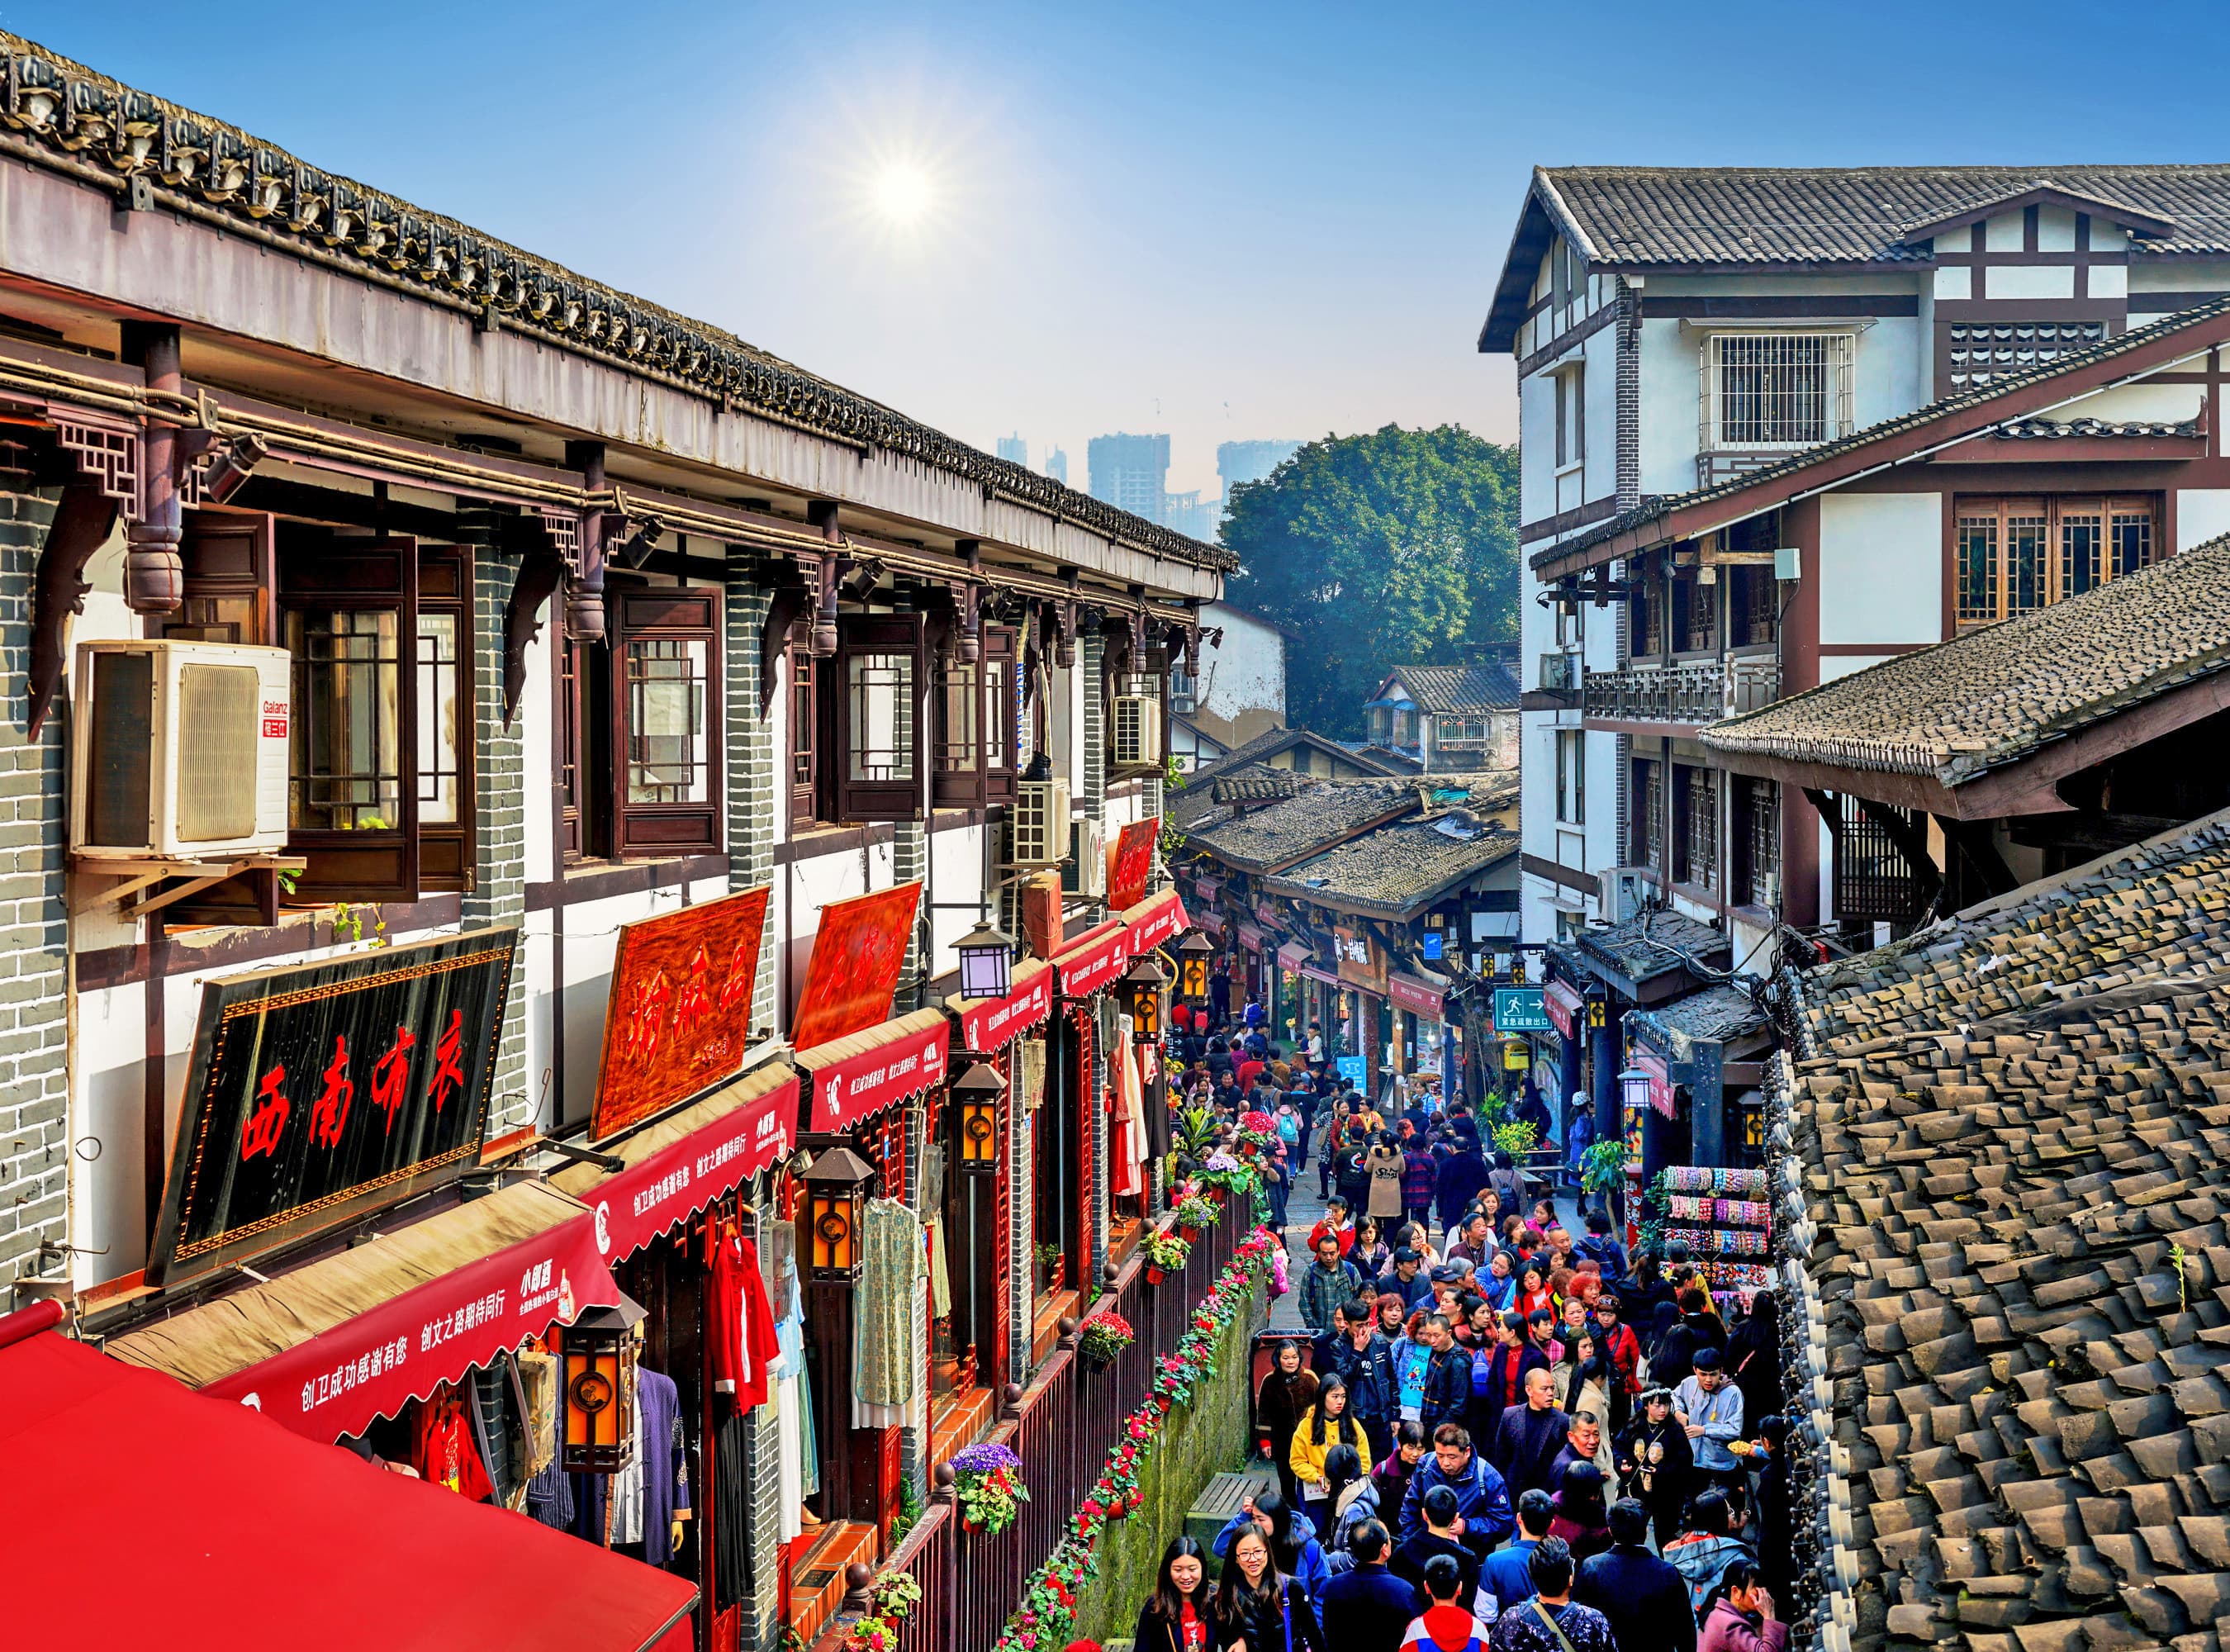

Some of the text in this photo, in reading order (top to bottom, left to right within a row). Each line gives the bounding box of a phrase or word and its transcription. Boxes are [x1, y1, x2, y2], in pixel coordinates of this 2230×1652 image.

[263, 700, 288, 714] Galanz
[1502, 1017, 1548, 1027] 紧急疏散出口
[241, 1009, 463, 1162] 西南布衣
[633, 1132, 747, 1217] 创卫成功感谢有您 创文之路期待同行
[520, 1258, 553, 1298] 小郎酒
[301, 1289, 506, 1412] 创卫成功感谢有您 创文之路期待同行
